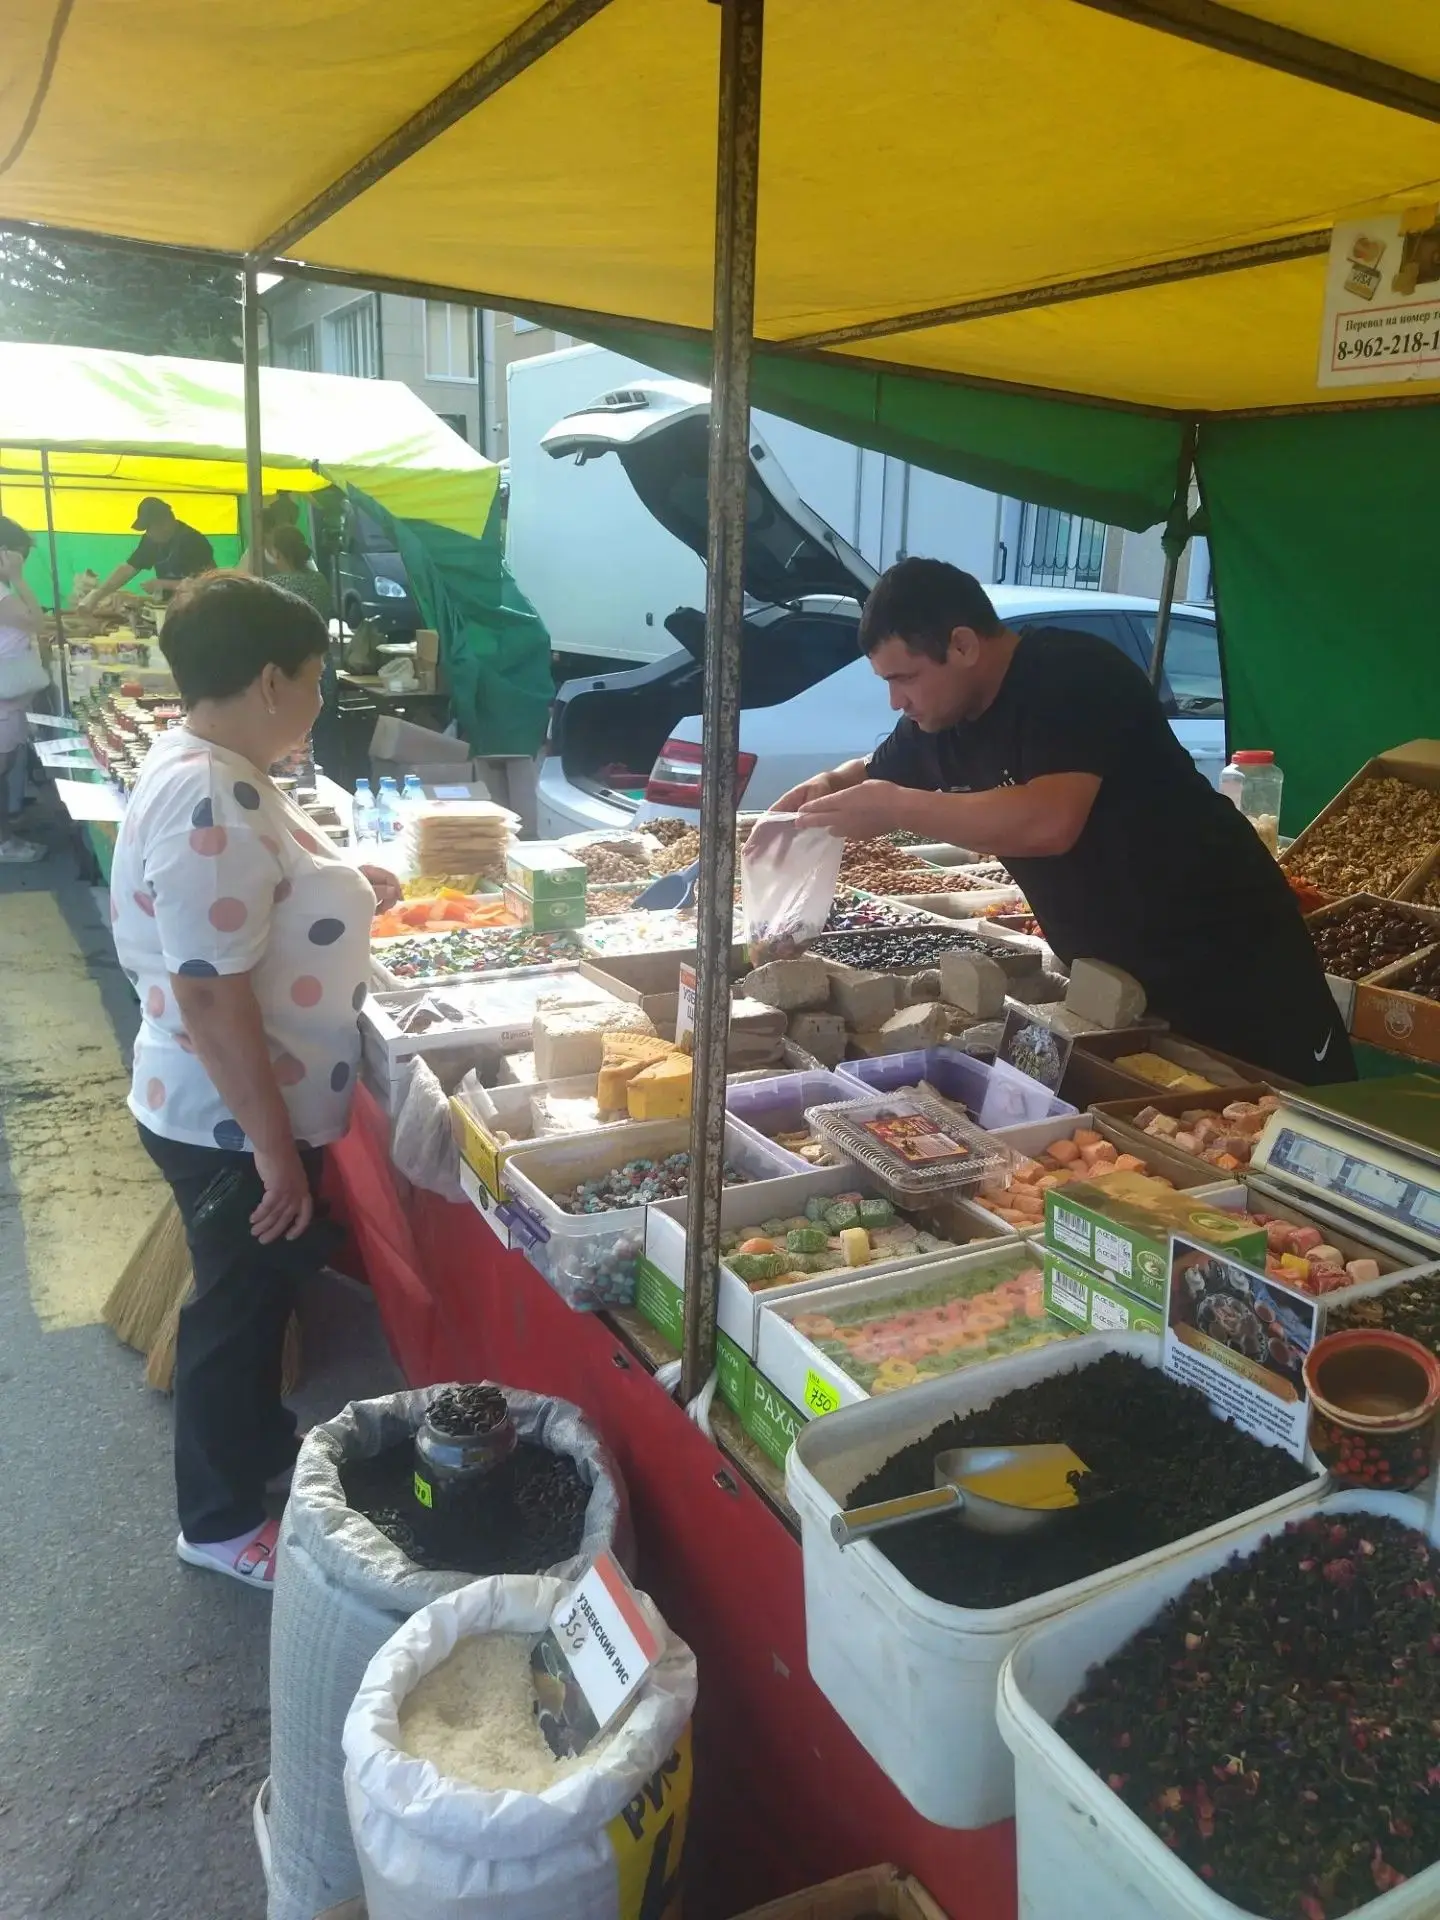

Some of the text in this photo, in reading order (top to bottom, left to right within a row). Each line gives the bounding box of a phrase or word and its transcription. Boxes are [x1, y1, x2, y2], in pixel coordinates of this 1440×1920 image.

[1353, 271, 1372, 286] VISA
[1346, 319, 1383, 332] Перевод
[1386, 316, 1397, 326] на
[1400, 311, 1430, 325] номер
[810, 1387, 832, 1412] 750
[576, 1592, 629, 1685] УЗБЕКСКИЙ РИС
